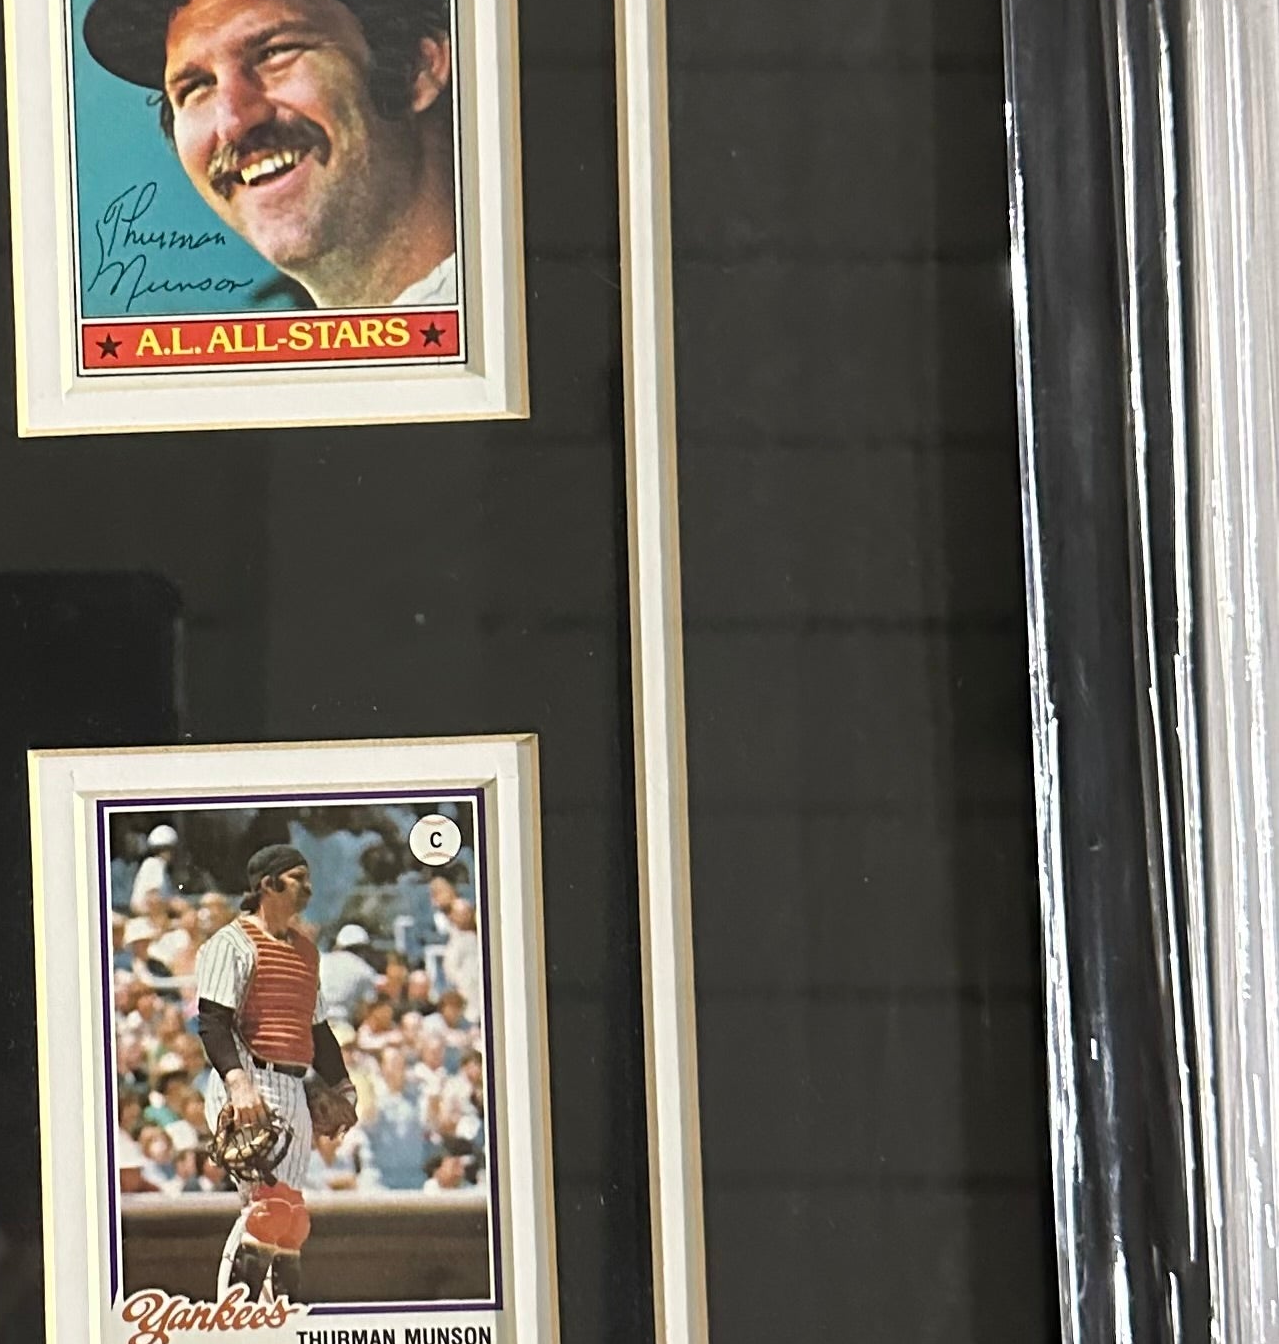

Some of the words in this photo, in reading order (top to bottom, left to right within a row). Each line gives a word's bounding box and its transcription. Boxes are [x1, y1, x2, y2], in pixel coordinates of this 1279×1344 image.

[135, 329, 202, 357] A.L.
[207, 316, 411, 354] ALL-STARS
[430, 830, 442, 849] C
